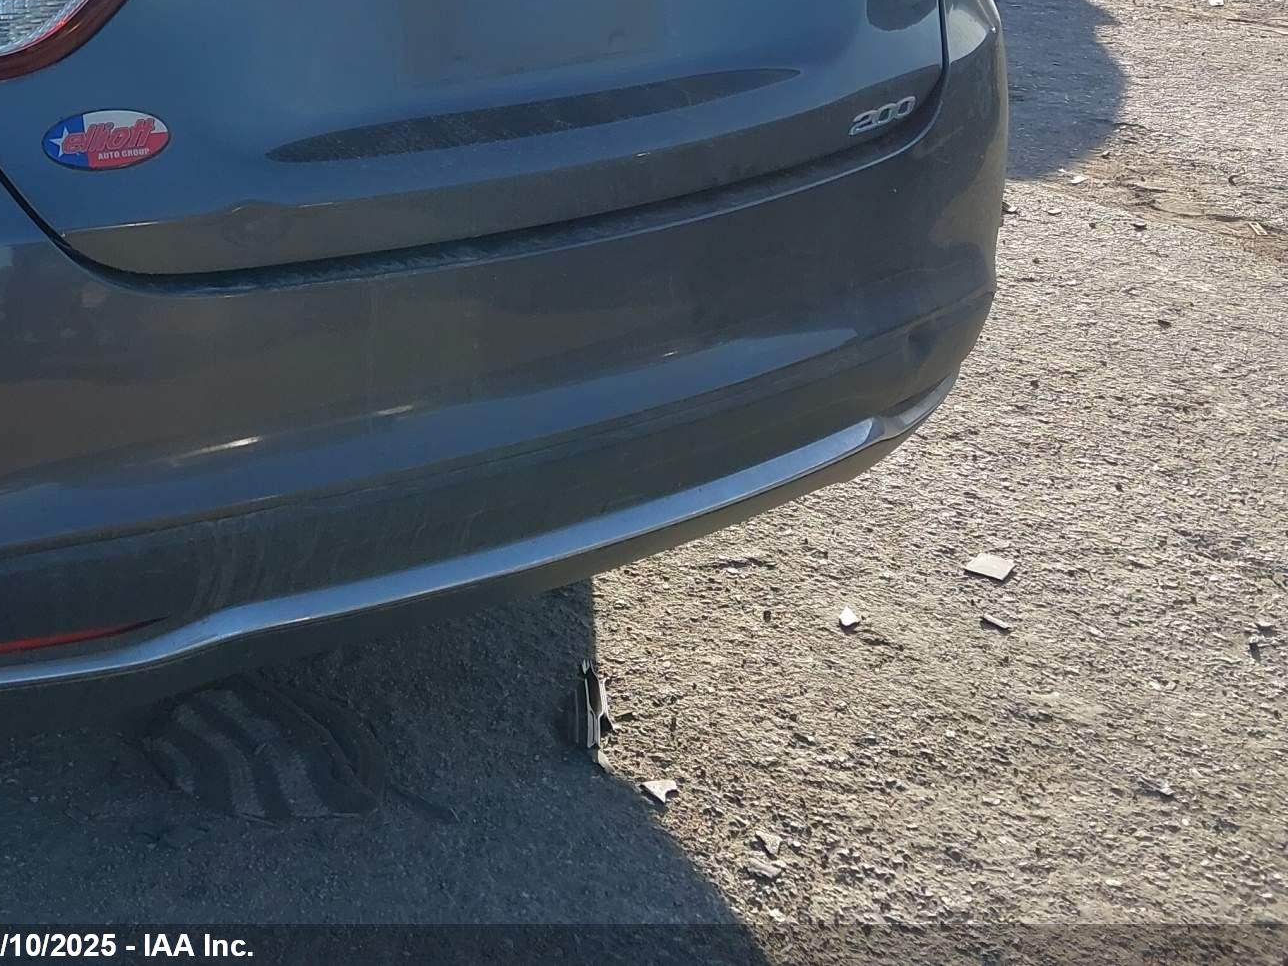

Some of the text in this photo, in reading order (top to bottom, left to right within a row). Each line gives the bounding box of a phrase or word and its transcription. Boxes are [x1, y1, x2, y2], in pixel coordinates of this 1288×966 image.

[849, 96, 916, 136] 200
[98, 147, 150, 161] AUTO GROUP
